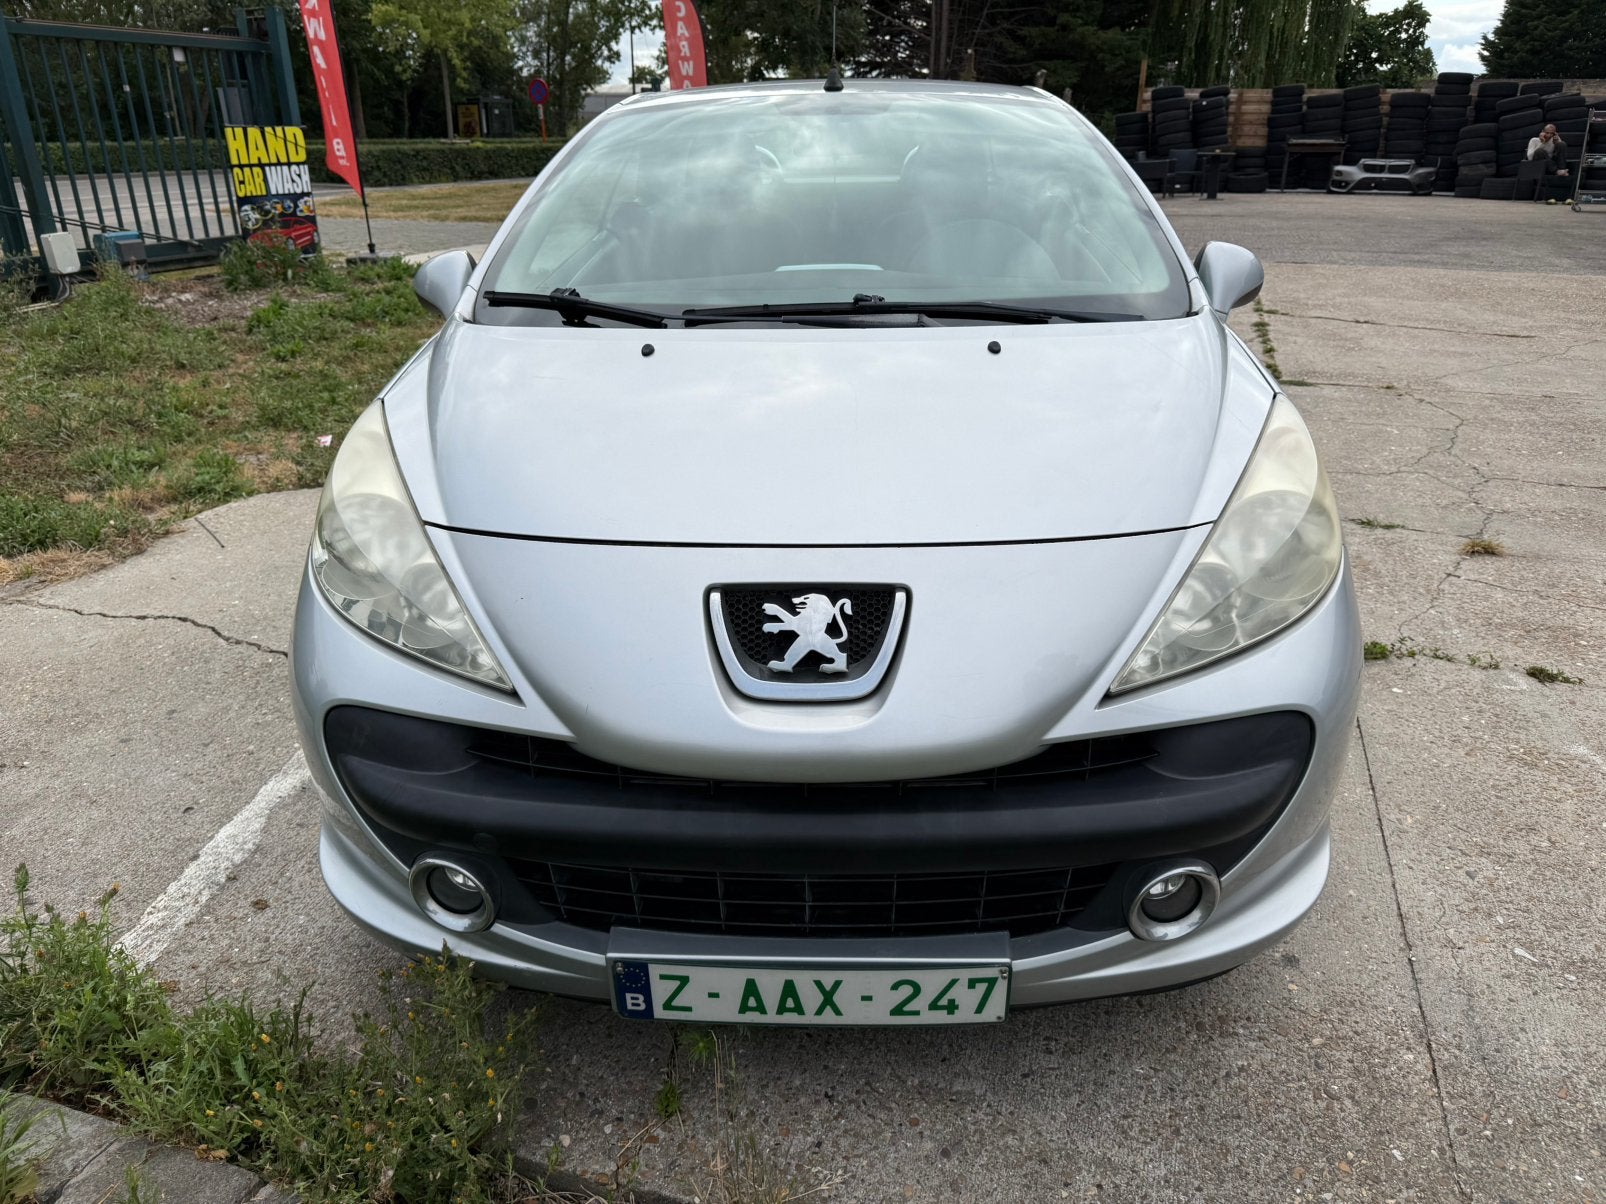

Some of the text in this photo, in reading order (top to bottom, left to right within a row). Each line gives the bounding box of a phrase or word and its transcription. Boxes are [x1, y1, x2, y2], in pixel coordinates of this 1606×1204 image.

[224, 126, 307, 165] HAND
[233, 164, 311, 197] CAR WASH
[625, 992, 646, 1010] B
